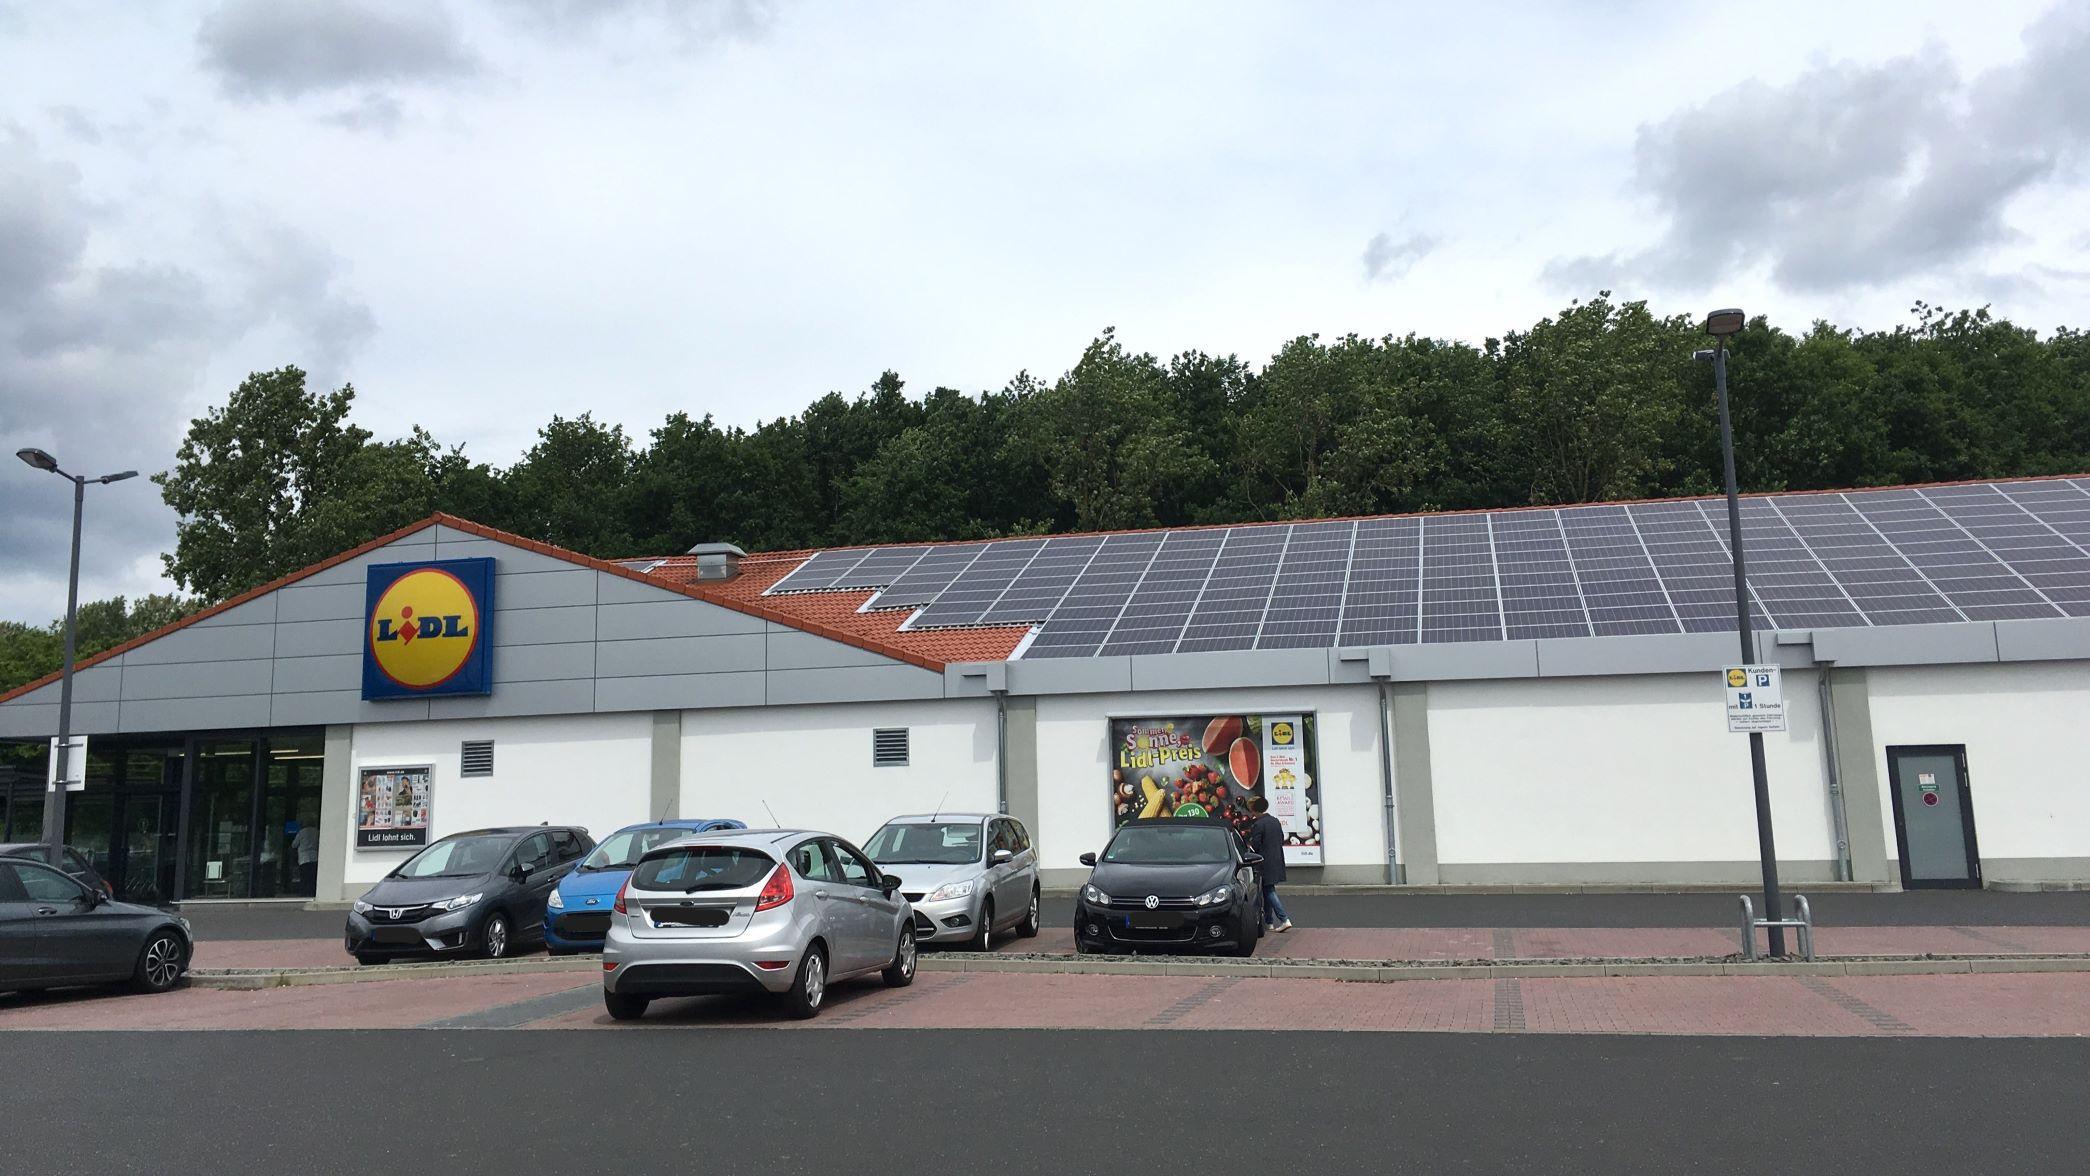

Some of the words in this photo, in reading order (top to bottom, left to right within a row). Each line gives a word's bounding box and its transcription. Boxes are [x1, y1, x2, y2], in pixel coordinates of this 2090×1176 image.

[377, 606, 468, 645] LIDL
[1757, 675, 1768, 686] P
[1121, 744, 1201, 768] Lidl-Preis
[1187, 807, 1200, 818] 130
[368, 834, 381, 842] Lidl
[382, 833, 400, 841] lohnt
[400, 833, 416, 841] sich.
